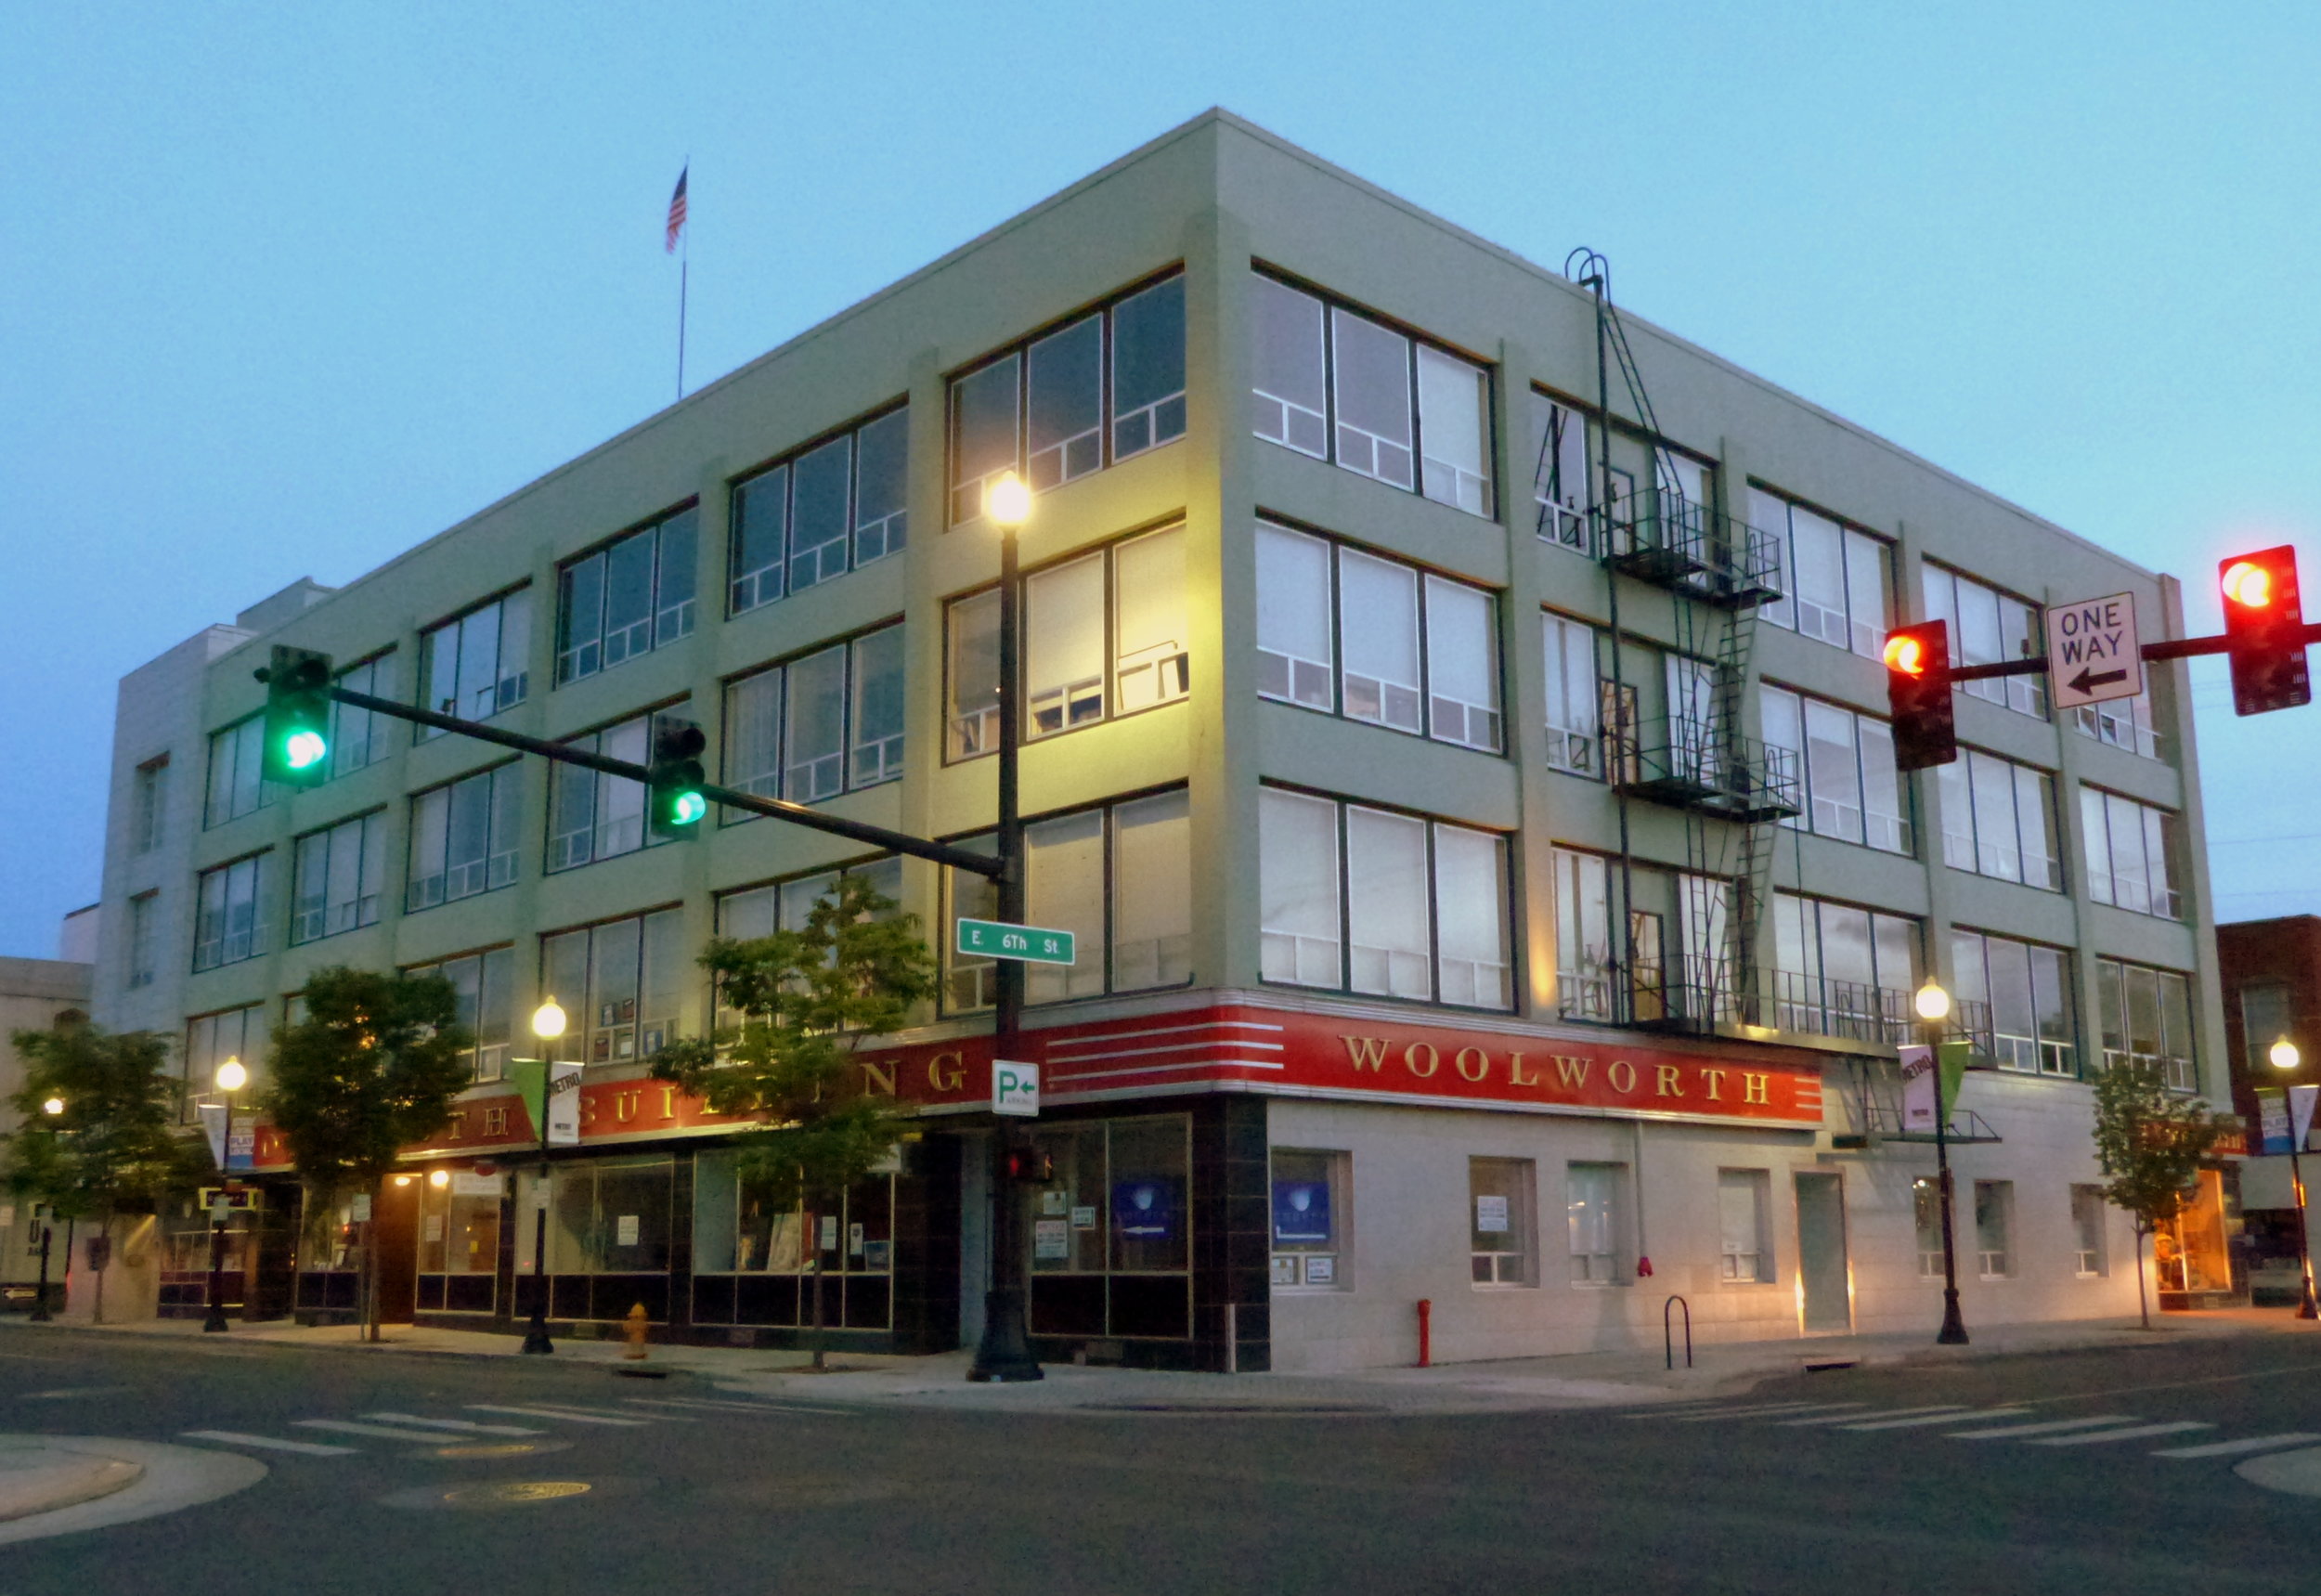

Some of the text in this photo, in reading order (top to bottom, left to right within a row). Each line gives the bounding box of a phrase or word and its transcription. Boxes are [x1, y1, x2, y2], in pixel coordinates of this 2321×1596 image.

[2061, 603, 2122, 637] ONE
[2062, 630, 2124, 666] WAY
[551, 1071, 581, 1096] METRO
[1338, 1034, 1770, 1105] WOOLWORTH
